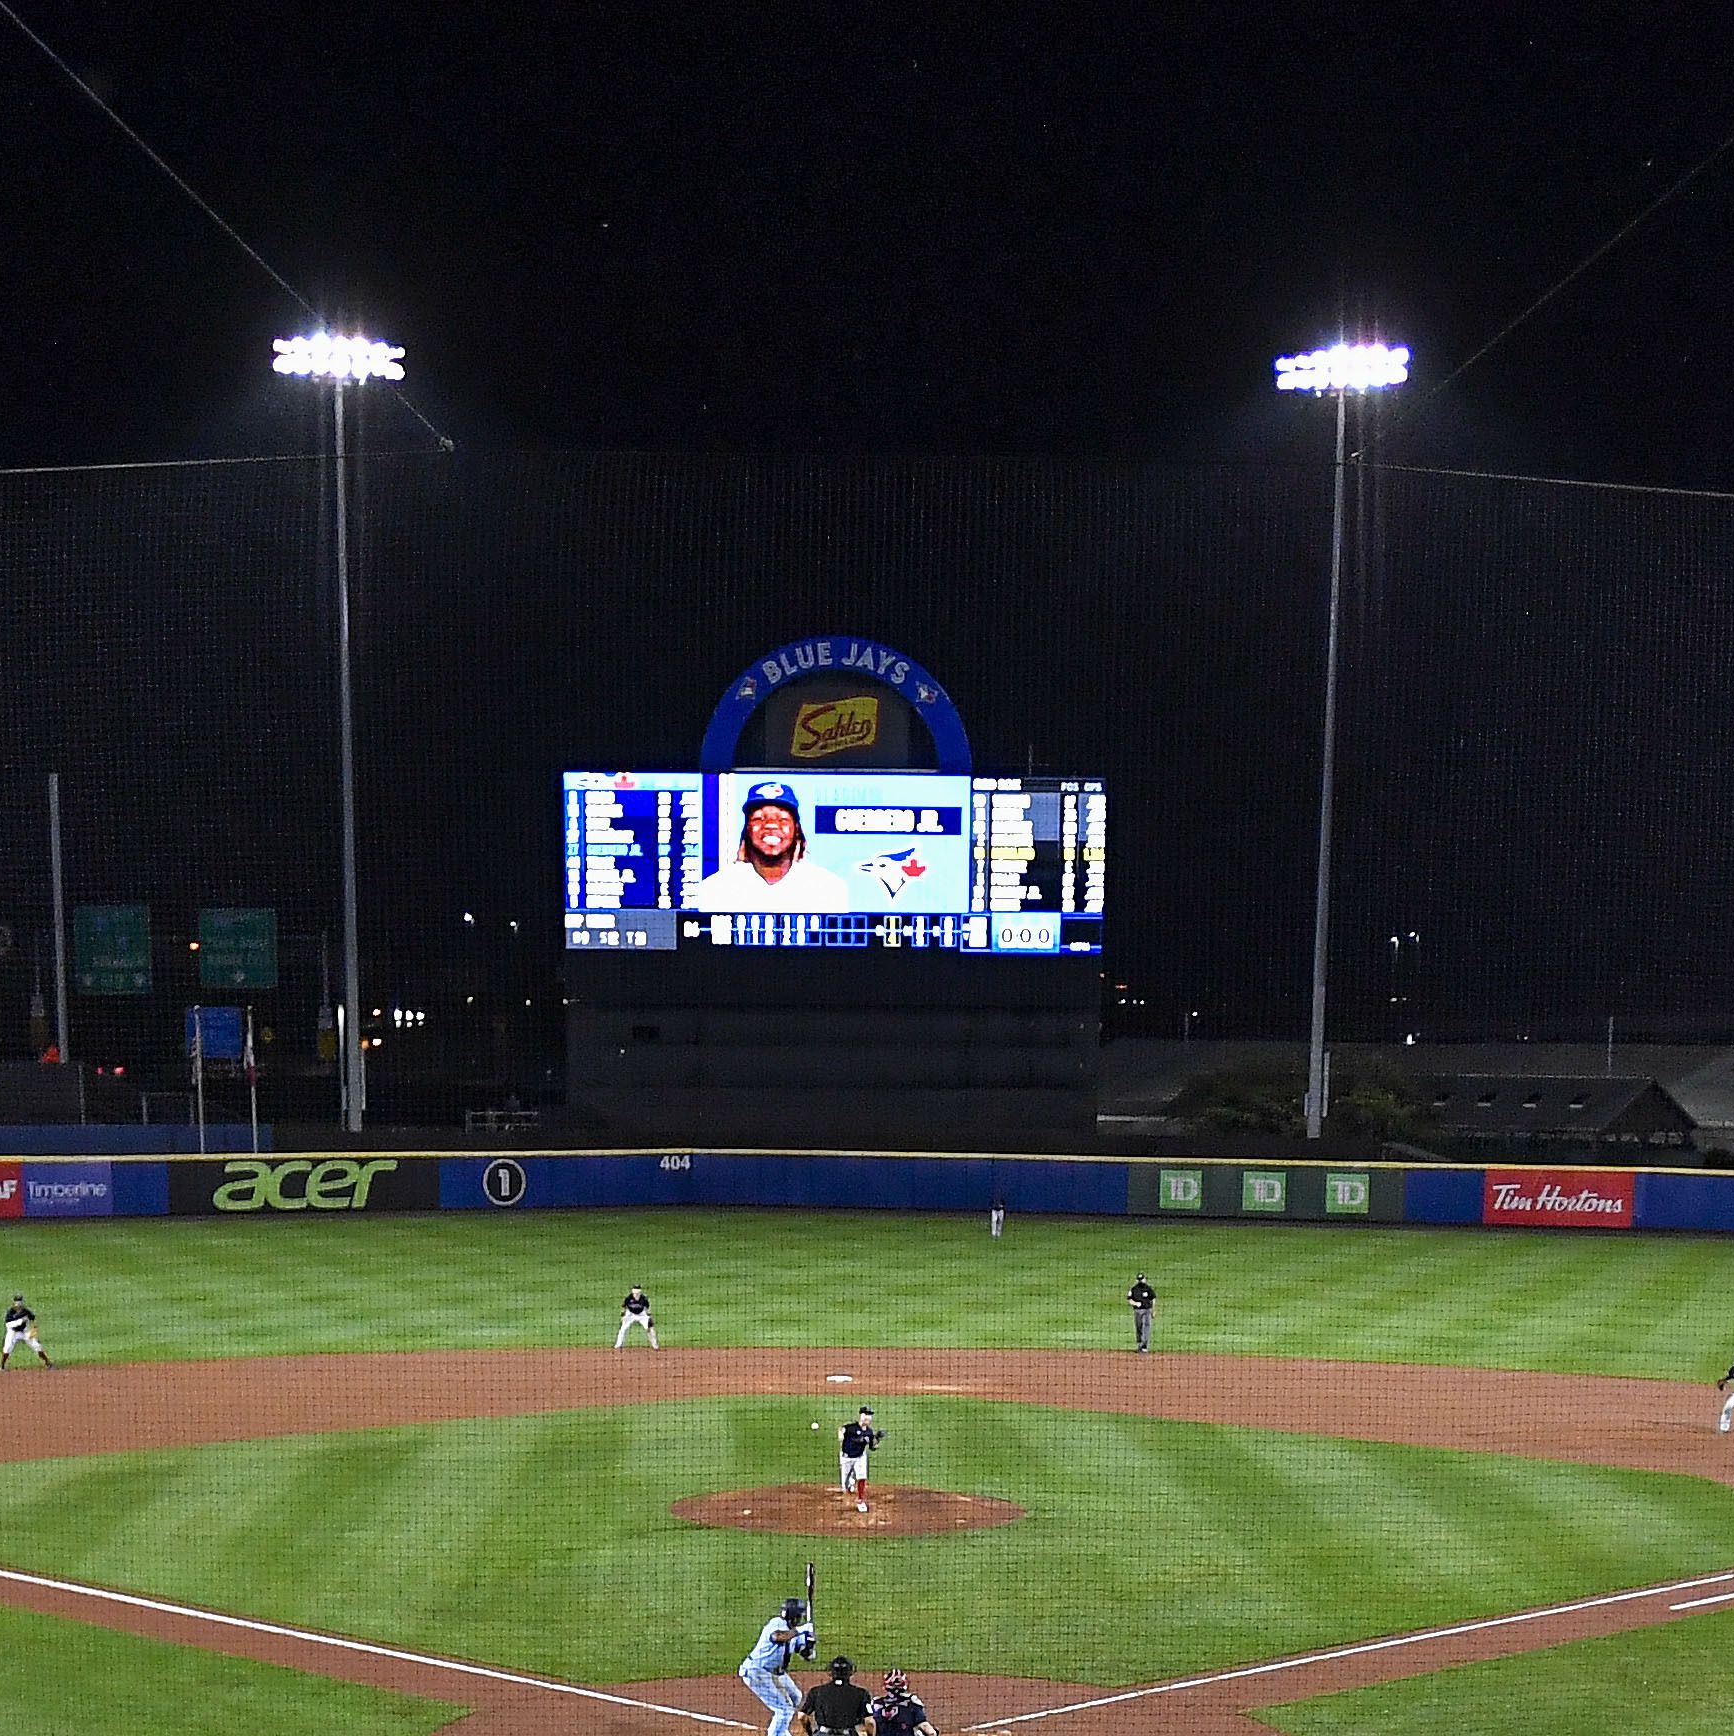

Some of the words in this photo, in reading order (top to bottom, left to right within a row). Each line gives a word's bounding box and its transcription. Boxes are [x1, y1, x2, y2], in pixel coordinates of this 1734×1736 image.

[762, 642, 833, 684] BLUE
[841, 643, 910, 684] JAYS
[660, 1155, 691, 1170] 404
[27, 1181, 107, 1199] Timberline
[212, 1159, 398, 1212] acer
[1165, 1177, 1198, 1200] TD
[1249, 1179, 1282, 1202] TD
[1331, 1180, 1365, 1205] TD
[1493, 1184, 1533, 1210] Tim
[1536, 1184, 1623, 1213] Hortons
